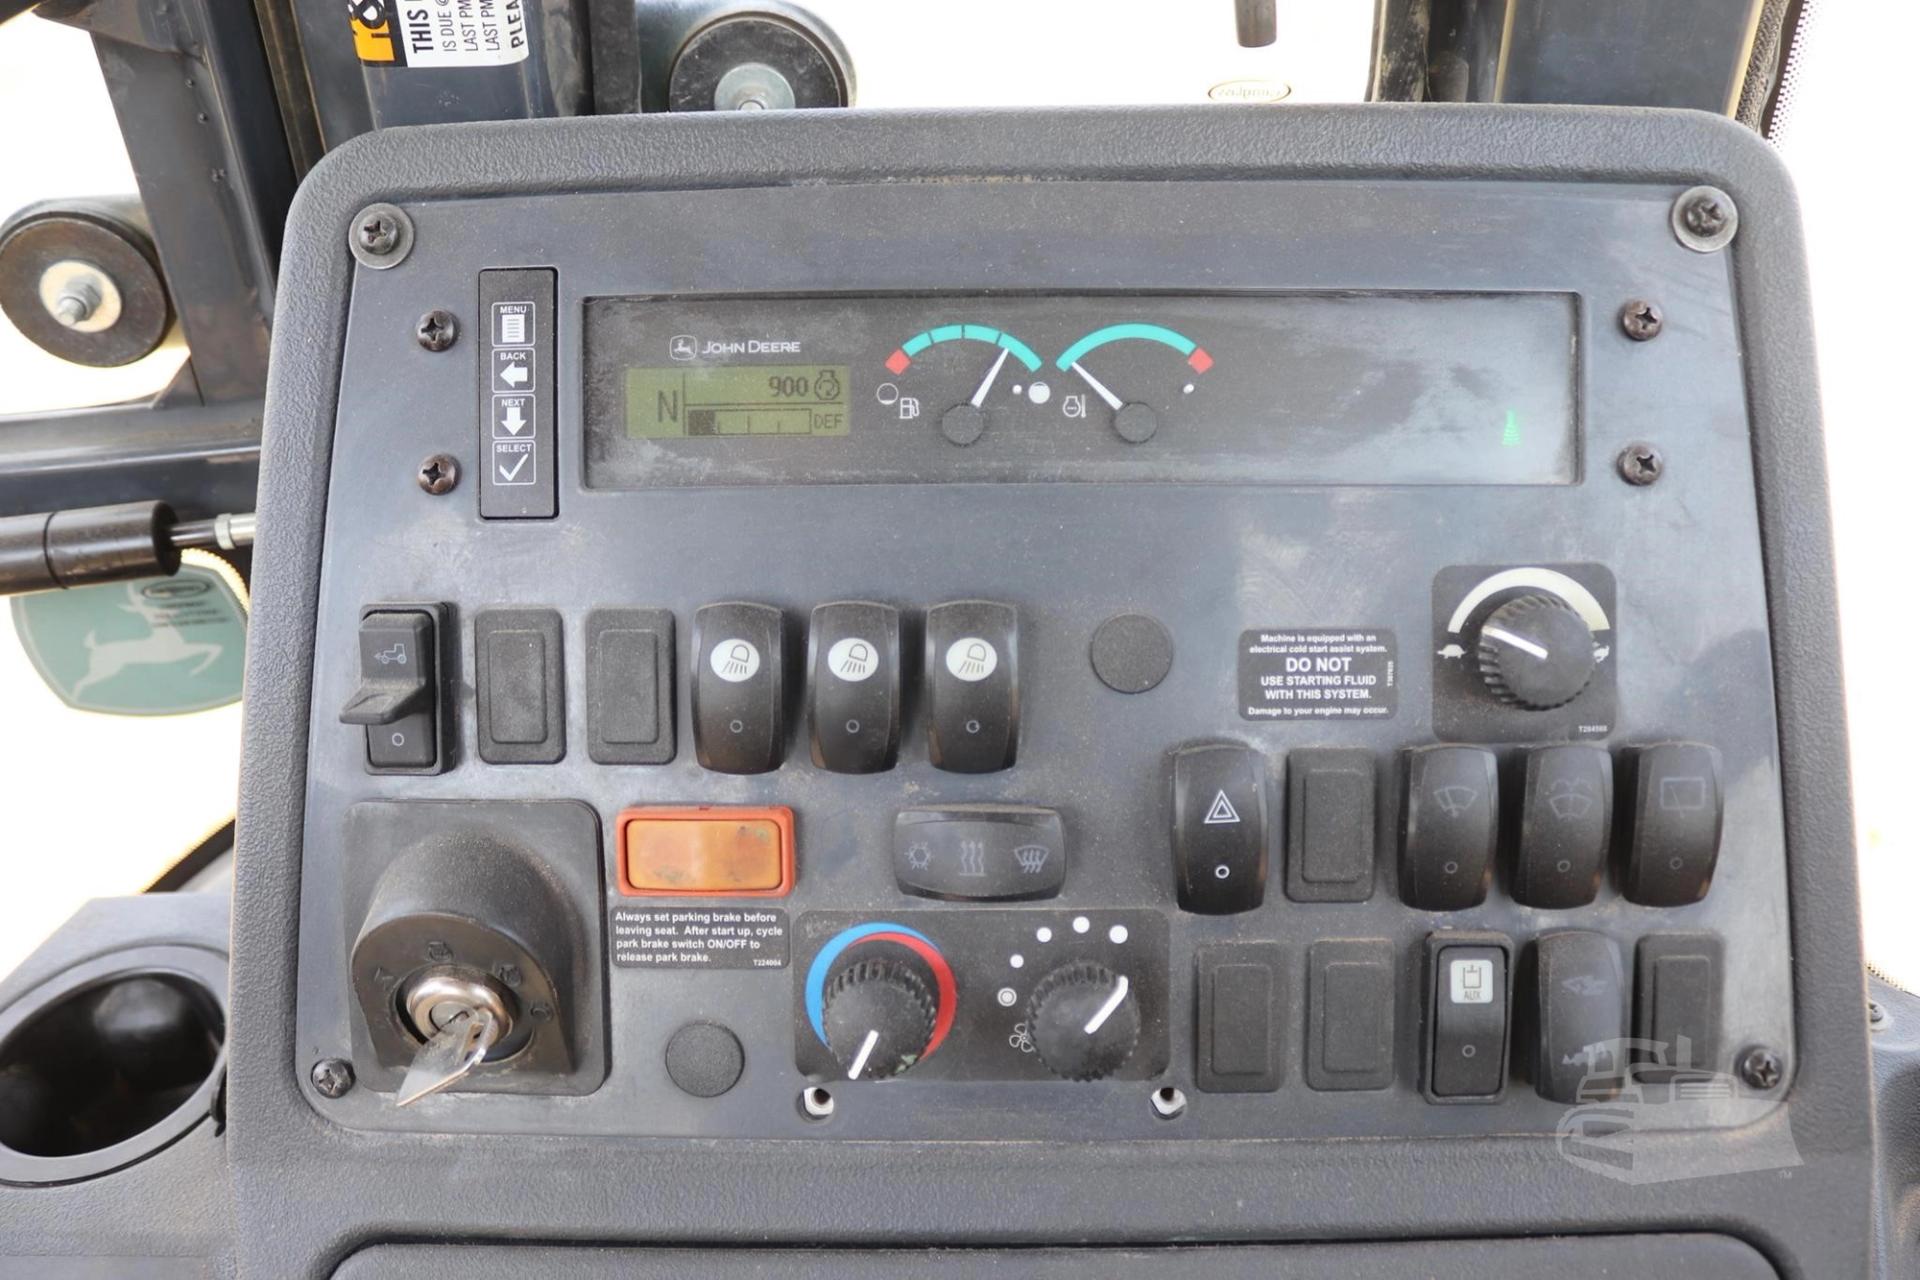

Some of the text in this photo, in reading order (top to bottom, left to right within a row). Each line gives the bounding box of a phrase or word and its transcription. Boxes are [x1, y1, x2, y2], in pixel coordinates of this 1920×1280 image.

[439, 11, 455, 39] DUE
[407, 9, 434, 54] THIS
[461, 21, 479, 52] LAST
[482, 20, 500, 51] LAST
[442, 40, 457, 52] IS
[500, 306, 527, 314] MENU
[702, 340, 801, 354] JOHN DEERE
[500, 352, 526, 361] BACK
[769, 376, 809, 397] 900
[501, 398, 525, 407] NEXT
[657, 390, 678, 422] N
[813, 414, 844, 429] DEF
[496, 444, 532, 452] SELECT
[1260, 634, 1296, 643] Machine
[1297, 634, 1306, 643] is
[1307, 634, 1346, 645] equipped
[1347, 634, 1365, 642] with
[1249, 645, 1287, 653] electrical
[1288, 645, 1307, 653] cold
[1308, 645, 1328, 653] start
[1355, 645, 1387, 655] system.
[1286, 657, 1352, 672] DO NOT
[1260, 676, 1377, 686] USE STARTING FLUID
[1265, 689, 1372, 700] WITH THIS SYSTEM.
[1248, 706, 1282, 717] Damage
[1283, 706, 1292, 715] to
[1293, 708, 1313, 717] your
[1314, 706, 1342, 716] engine
[1343, 707, 1361, 716] may
[615, 912, 777, 924] Always set parking brake before
[616, 925, 783, 937] leaving seat. After start up, cycle
[616, 939, 760, 950] park brake switch ON/OFF to
[616, 952, 711, 963] release park brake.
